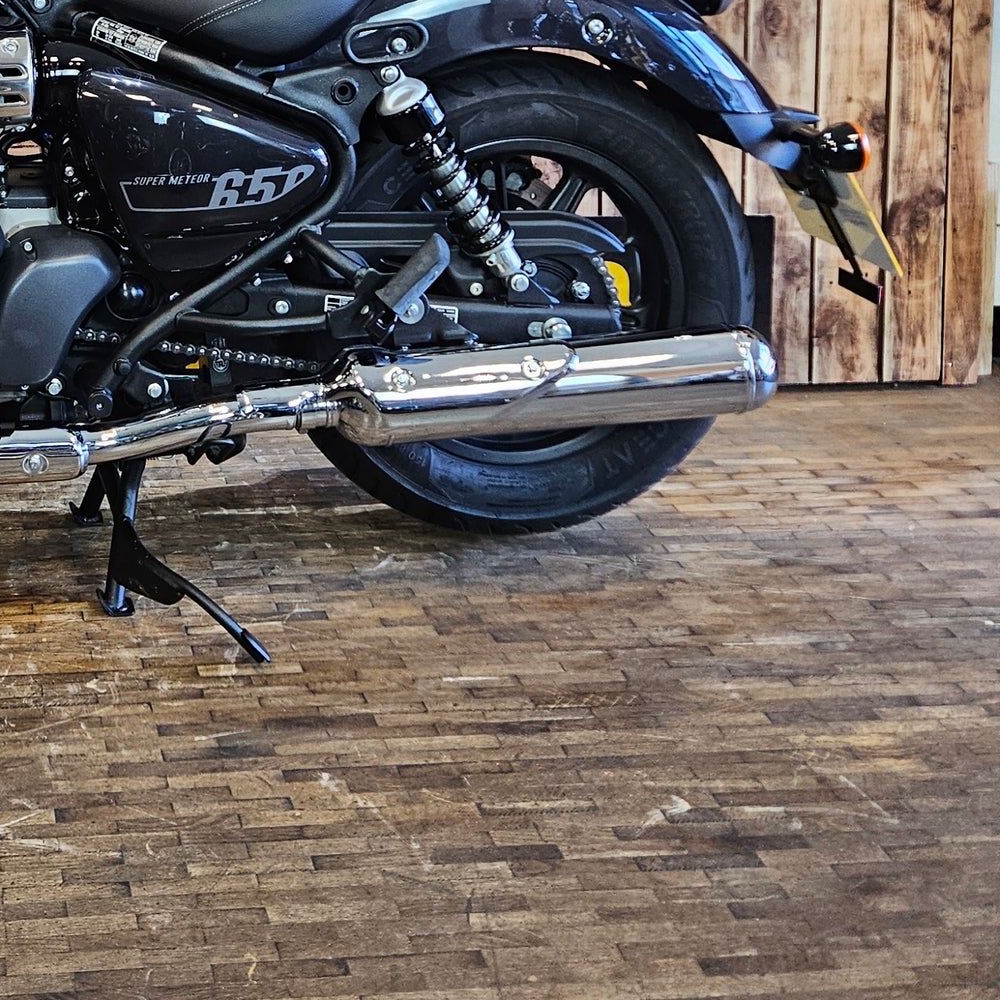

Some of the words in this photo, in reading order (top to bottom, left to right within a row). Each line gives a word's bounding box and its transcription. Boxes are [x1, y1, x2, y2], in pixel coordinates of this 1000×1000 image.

[132, 176, 166, 186] SUPER
[168, 173, 212, 185] METEOR
[208, 164, 316, 208] 650
